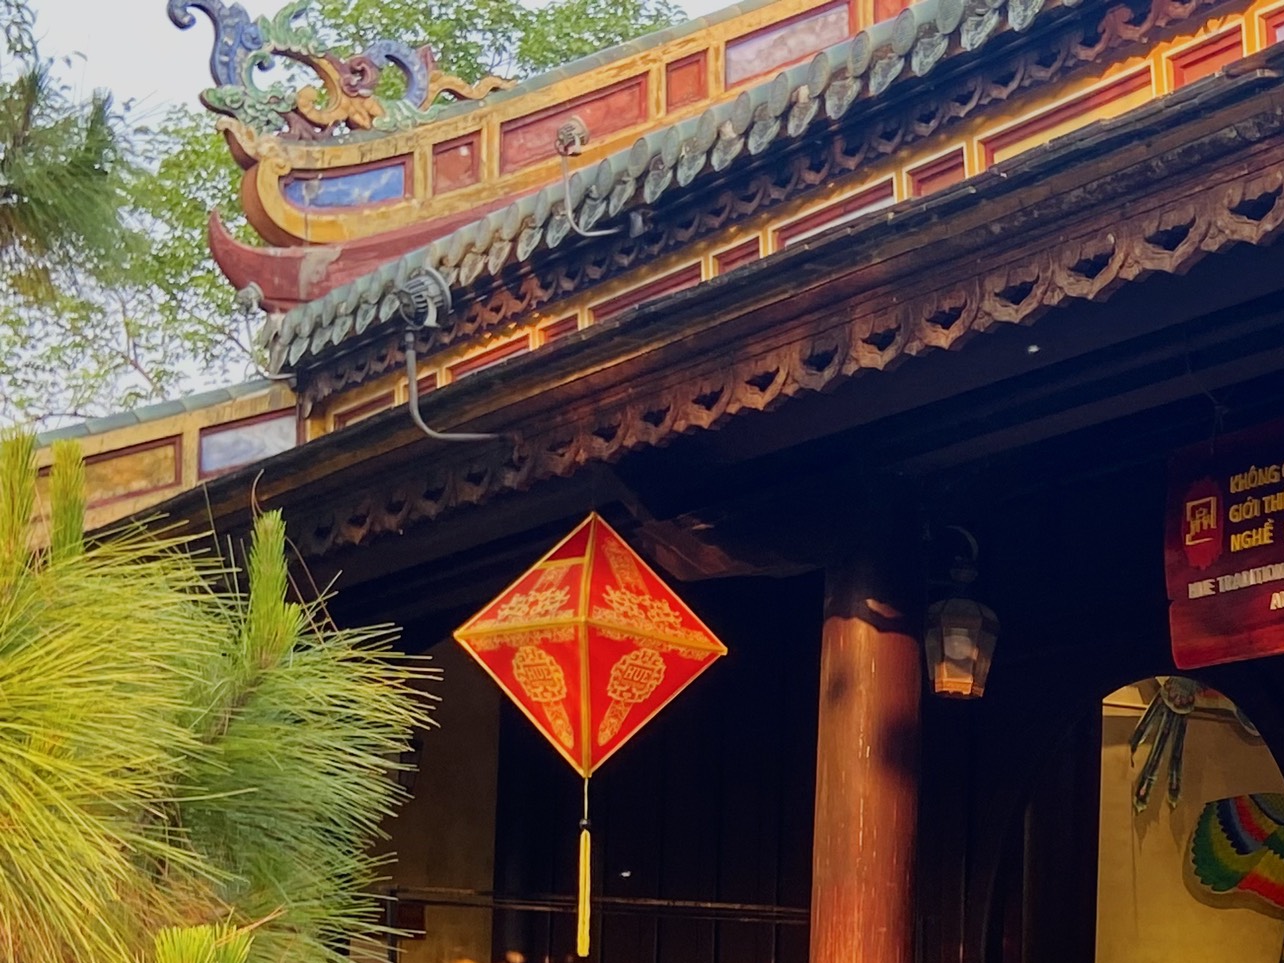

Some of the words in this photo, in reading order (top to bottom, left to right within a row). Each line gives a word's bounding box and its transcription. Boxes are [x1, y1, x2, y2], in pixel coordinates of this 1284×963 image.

[1229, 464, 1281, 494] KHÔNG
[1228, 495, 1261, 523] GIỚI
[625, 667, 650, 684] HUE
